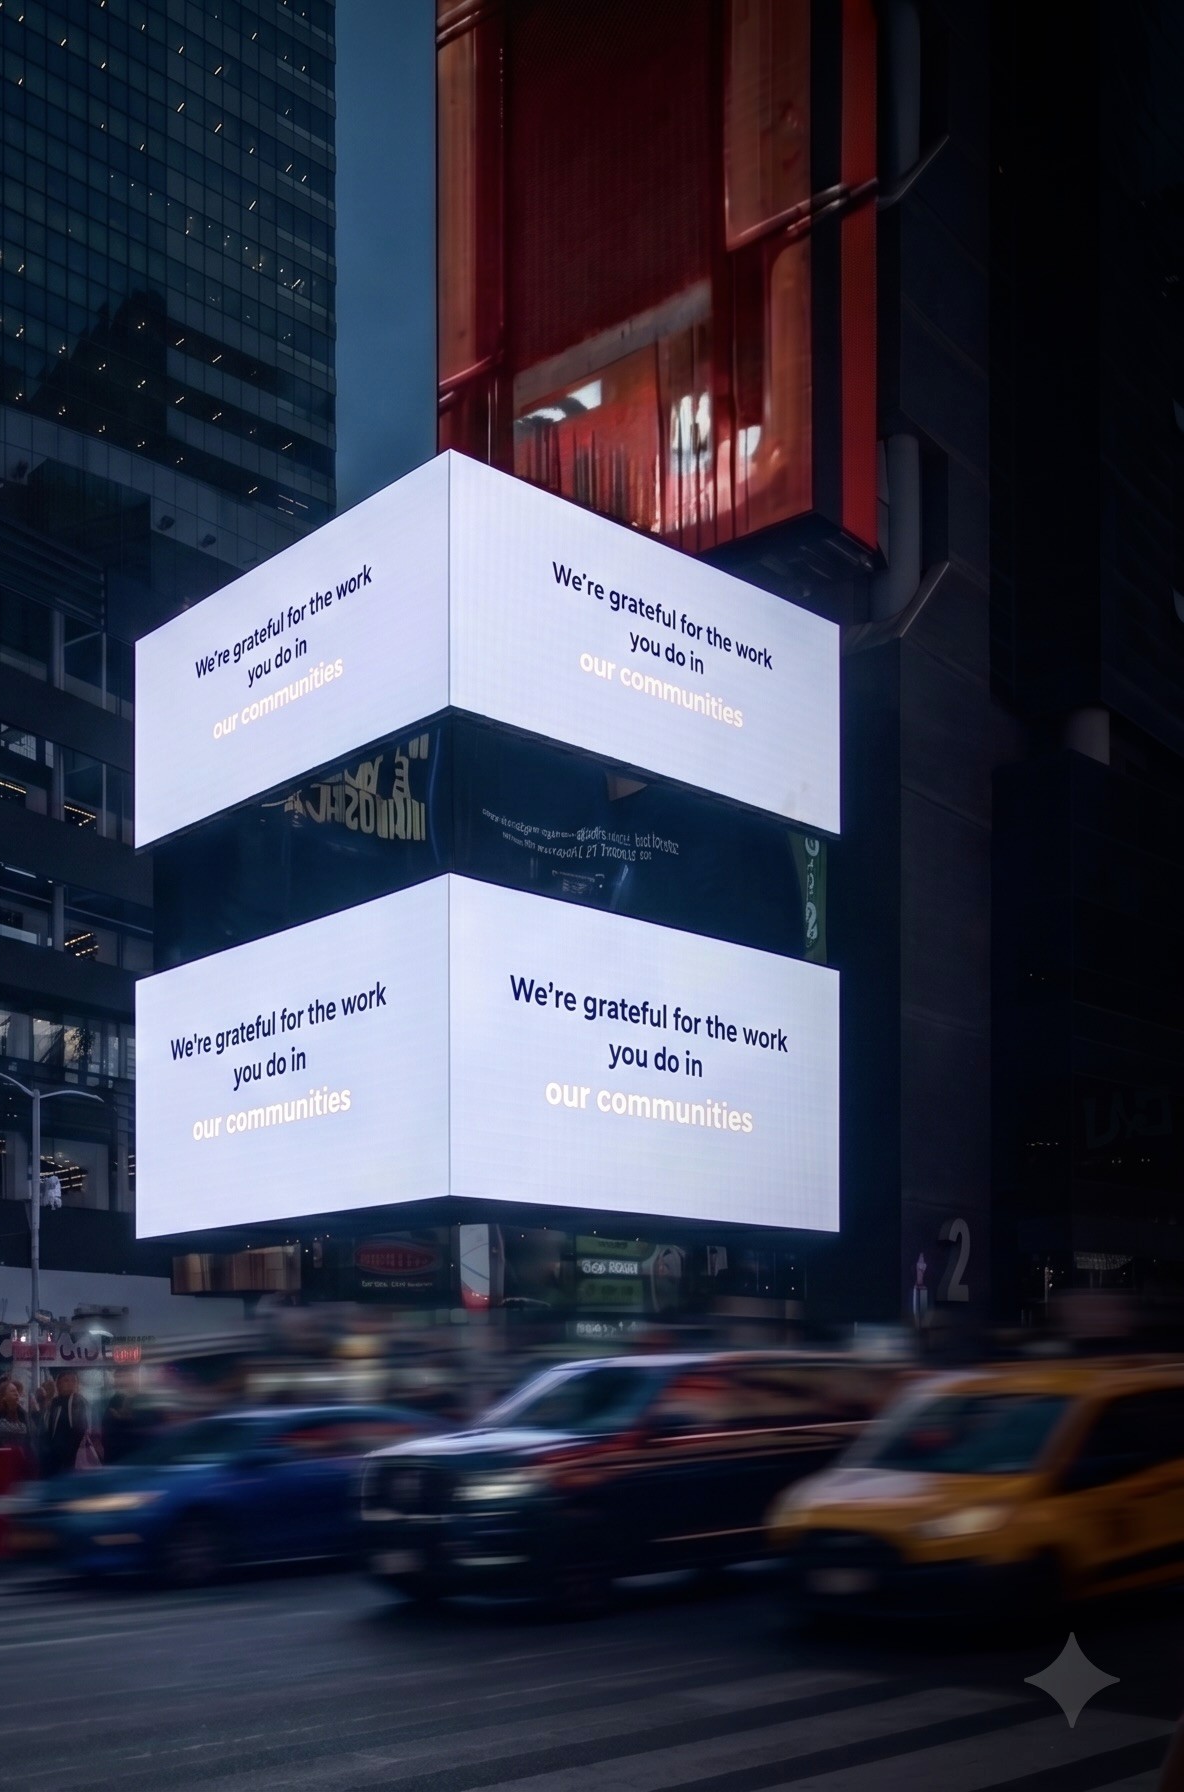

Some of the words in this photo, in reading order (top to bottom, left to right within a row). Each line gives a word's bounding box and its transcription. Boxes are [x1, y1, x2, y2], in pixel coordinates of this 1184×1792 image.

[233, 611, 284, 664] grateful
[286, 605, 307, 629] for
[308, 590, 333, 616] the
[335, 564, 373, 601] work
[609, 589, 677, 631] grateful
[680, 613, 704, 641] for
[705, 625, 732, 653] the
[735, 640, 773, 671] work
[247, 658, 272, 689] you
[274, 645, 292, 670] do
[295, 637, 308, 659] in
[629, 631, 661, 659] you
[664, 642, 686, 667] do
[690, 649, 705, 675] in
[212, 713, 239, 740] our
[240, 657, 344, 726] communities
[579, 652, 616, 680] our
[619, 666, 744, 729] communities
[215, 1010, 276, 1056] grateful
[279, 1007, 304, 1033] for
[307, 998, 337, 1025] the
[340, 981, 387, 1016] work
[582, 995, 668, 1029] grateful
[672, 1006, 703, 1035] for
[705, 1014, 738, 1043] the
[742, 1026, 789, 1053] work
[233, 1062, 262, 1092] you
[266, 1051, 287, 1078] do
[291, 1046, 307, 1072] in
[608, 1043, 649, 1070] you
[653, 1045, 680, 1074] do
[684, 1049, 704, 1078] in
[192, 1115, 223, 1142] our
[225, 1086, 352, 1134] communities
[545, 1081, 591, 1110] our
[596, 1089, 754, 1134] communities
[937, 1217, 971, 1303] 2
